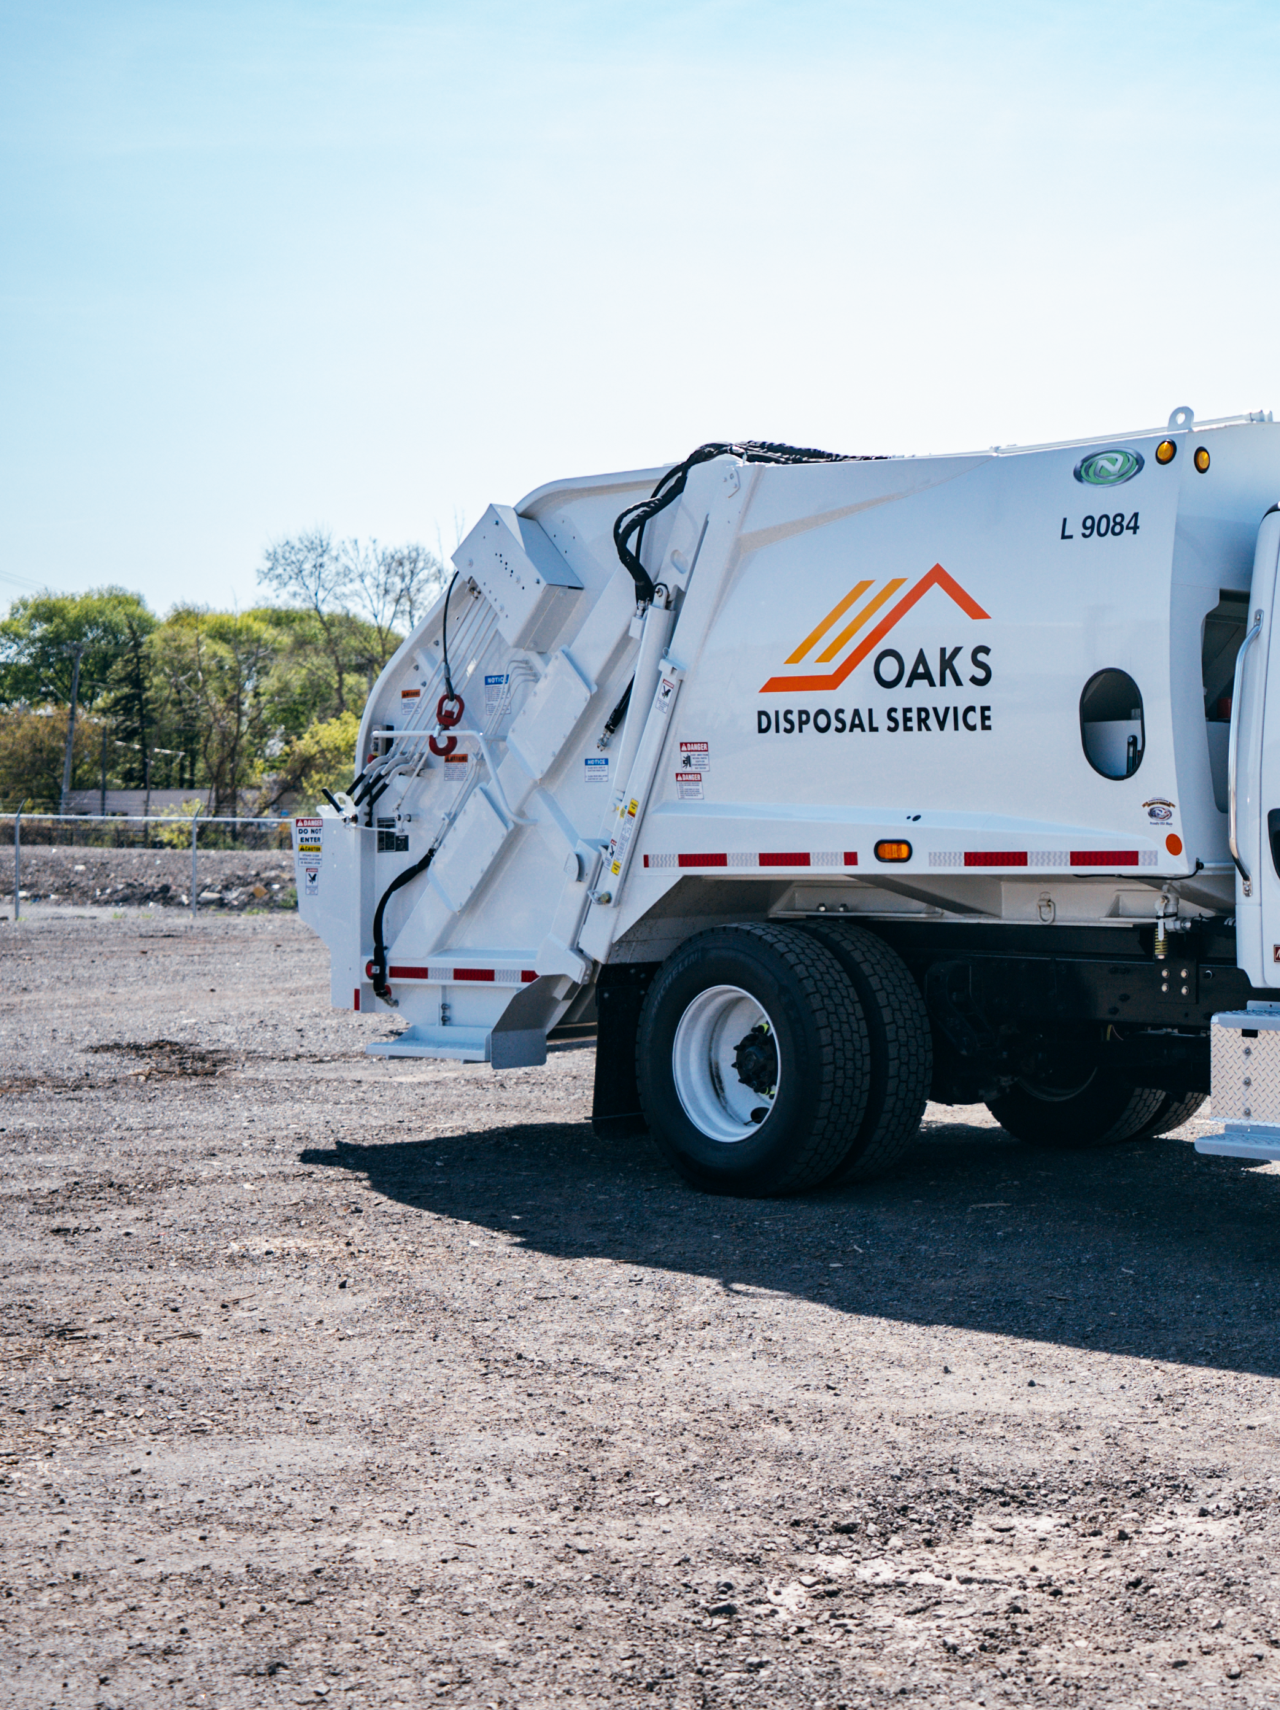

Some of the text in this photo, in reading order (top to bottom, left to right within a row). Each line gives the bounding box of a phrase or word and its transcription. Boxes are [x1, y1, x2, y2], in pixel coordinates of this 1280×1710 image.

[1061, 512, 1140, 540] L 9084
[873, 645, 993, 689] OAKS
[757, 705, 993, 734] DISPOSAL SERVICE
[687, 743, 708, 751] DANGER
